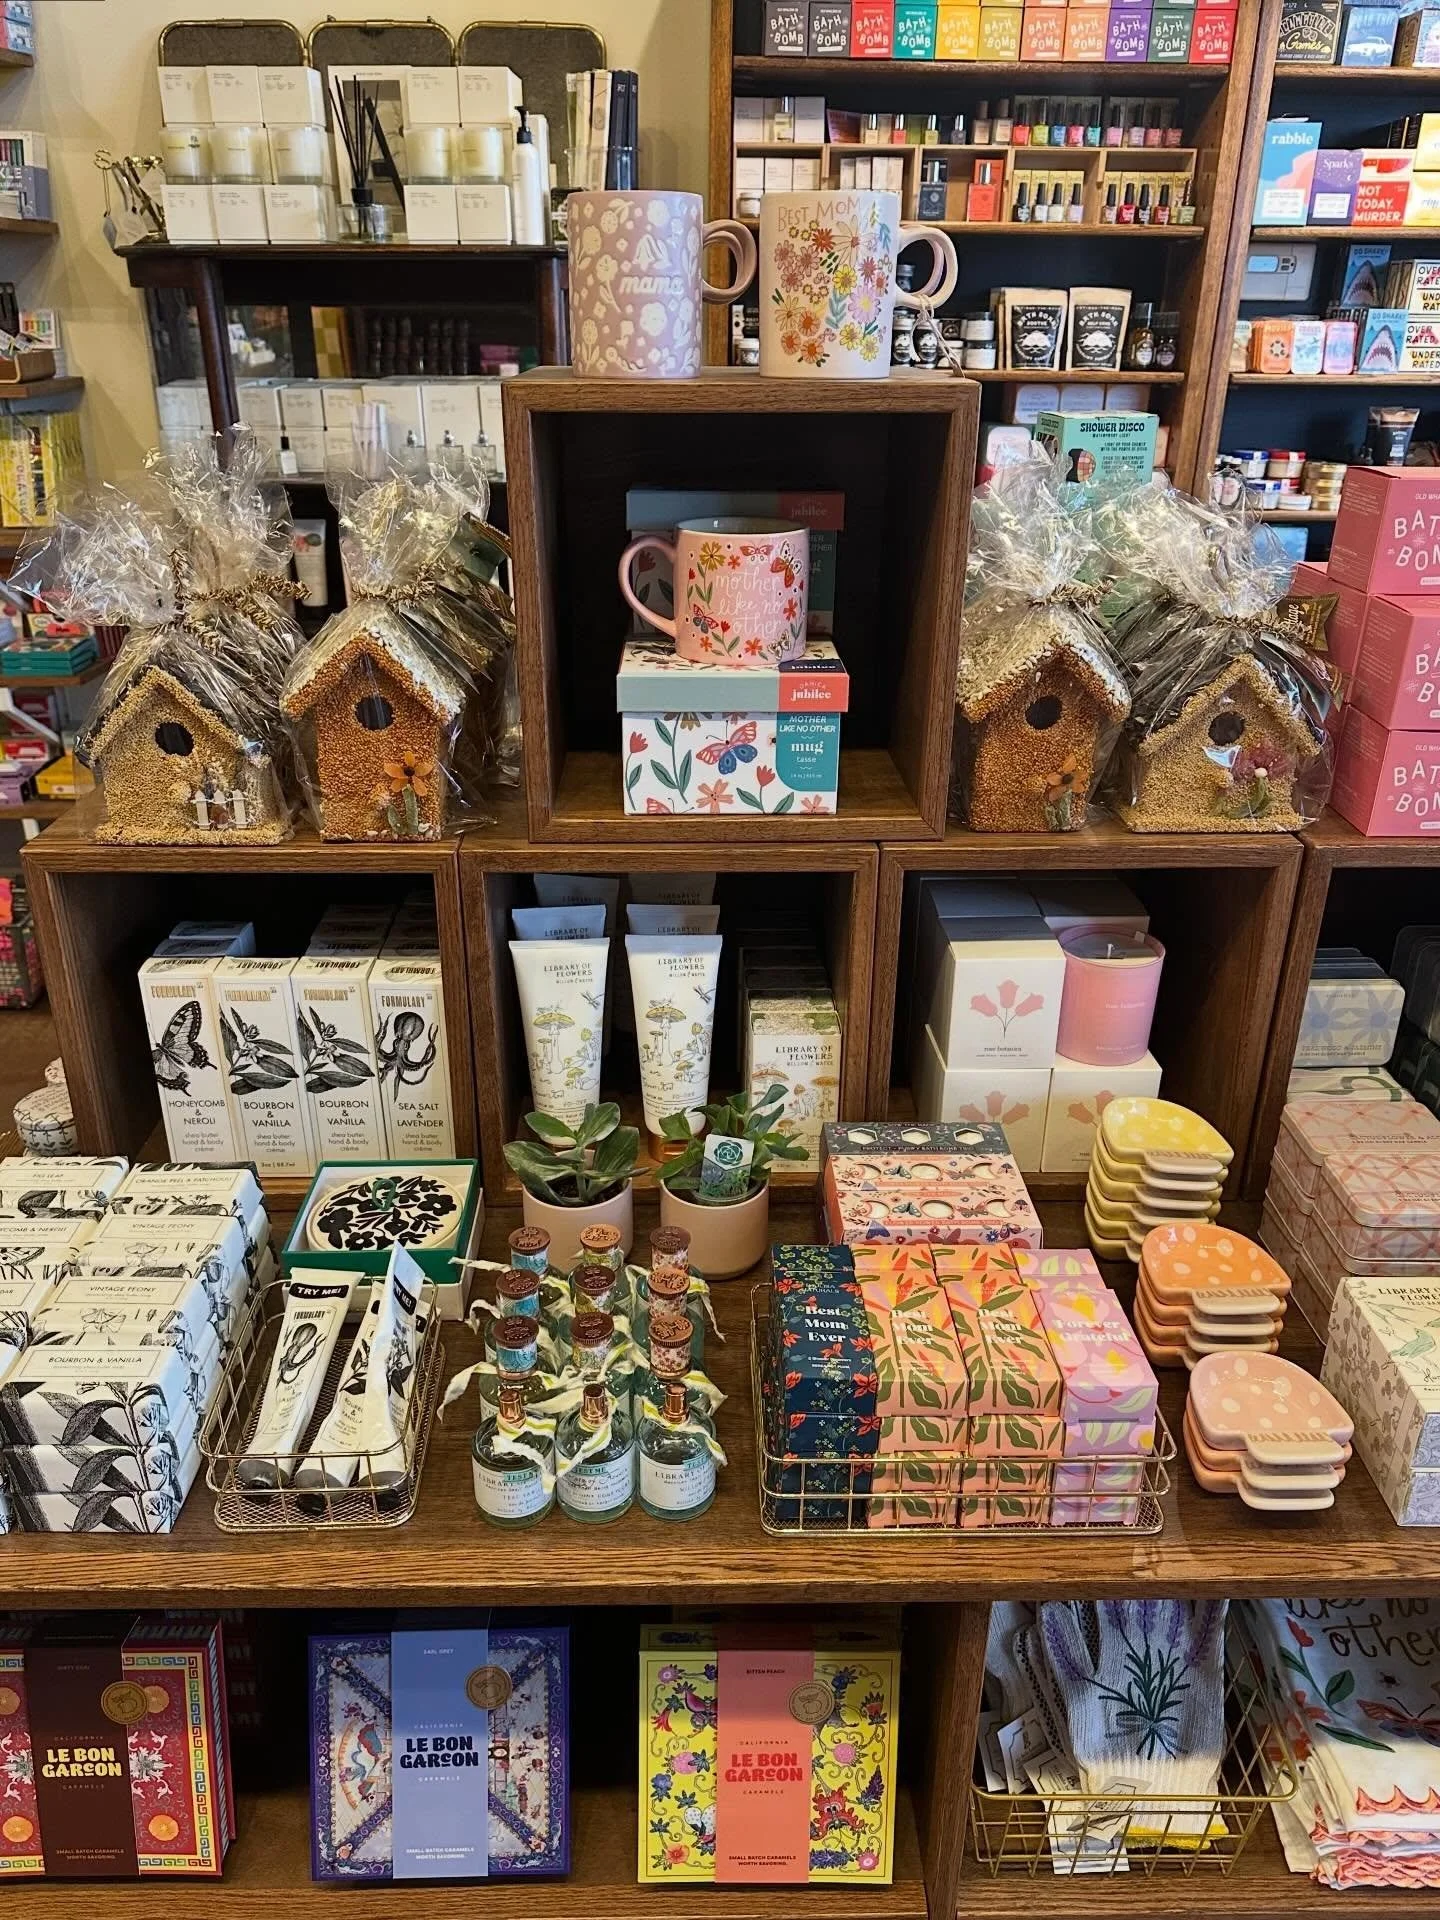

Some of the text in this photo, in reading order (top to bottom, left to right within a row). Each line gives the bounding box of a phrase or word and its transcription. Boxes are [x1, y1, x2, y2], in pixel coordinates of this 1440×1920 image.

[771, 14, 799, 30] BATH
[814, 14, 842, 32] BATH
[856, 15, 883, 32] BATH
[899, 16, 926, 32] BATH
[984, 17, 1012, 33] BATH
[1028, 18, 1056, 34] BATH
[1112, 20, 1140, 36] BATH
[1156, 20, 1183, 37] BATH
[1198, 21, 1226, 38] BATH
[774, 31, 804, 46] BOMB
[816, 32, 846, 46] BOMB
[859, 32, 889, 46] BOMB
[902, 33, 931, 48] BOMB
[986, 34, 1016, 49] BOMB
[1030, 35, 1060, 50] BOMB
[1115, 37, 1144, 51] BOMB
[1157, 37, 1186, 51] BOMB
[1200, 37, 1229, 52] BOMB
[1286, 32, 1324, 50] Games
[1272, 132, 1314, 145] rabble
[1323, 159, 1353, 170] Sparks
[1358, 186, 1381, 196] NOT
[1356, 198, 1393, 210] TODAY.
[778, 199, 861, 232] BEST MOM
[1354, 211, 1404, 222] MURDER.
[619, 275, 684, 294] mama
[1416, 277, 1440, 286] RATE
[1422, 292, 1440, 301] UND
[1422, 302, 1440, 310] RAT
[1408, 326, 1432, 334] OVER
[1412, 350, 1440, 360] UNDER
[1412, 360, 1440, 368] RATED
[1080, 422, 1145, 432] SHOWER DISCO
[1394, 509, 1440, 539] BAT
[716, 568, 780, 593] mother
[718, 594, 781, 616] like no
[732, 616, 781, 637] other
[790, 688, 832, 702] jubilee
[789, 716, 827, 724] MOTHER
[791, 740, 824, 755] mug
[1394, 759, 1440, 787] BAT
[544, 928, 577, 937] LIBRARY
[544, 964, 580, 972] LIBRARY
[150, 986, 196, 998] FORMULARY
[304, 989, 348, 1001] FORMULARY
[381, 996, 425, 1007] FORMULARY
[297, 1286, 320, 1295] TRY
[294, 1311, 325, 1320] FORMULARY
[805, 1306, 842, 1316] Best
[892, 1310, 928, 1319] Best
[978, 1309, 1014, 1318] Best
[805, 1318, 845, 1330] Mom
[893, 1323, 933, 1332] Mom
[981, 1322, 1022, 1331] Mom
[1052, 1320, 1120, 1328] Forever
[808, 1332, 846, 1342] Ever
[897, 1336, 933, 1345] Ever
[986, 1335, 1022, 1344] Ever
[1064, 1333, 1130, 1346] Grateful
[406, 1736, 473, 1753] LE BON
[47, 1748, 115, 1763] LE BON
[731, 1752, 798, 1768] LE BON
